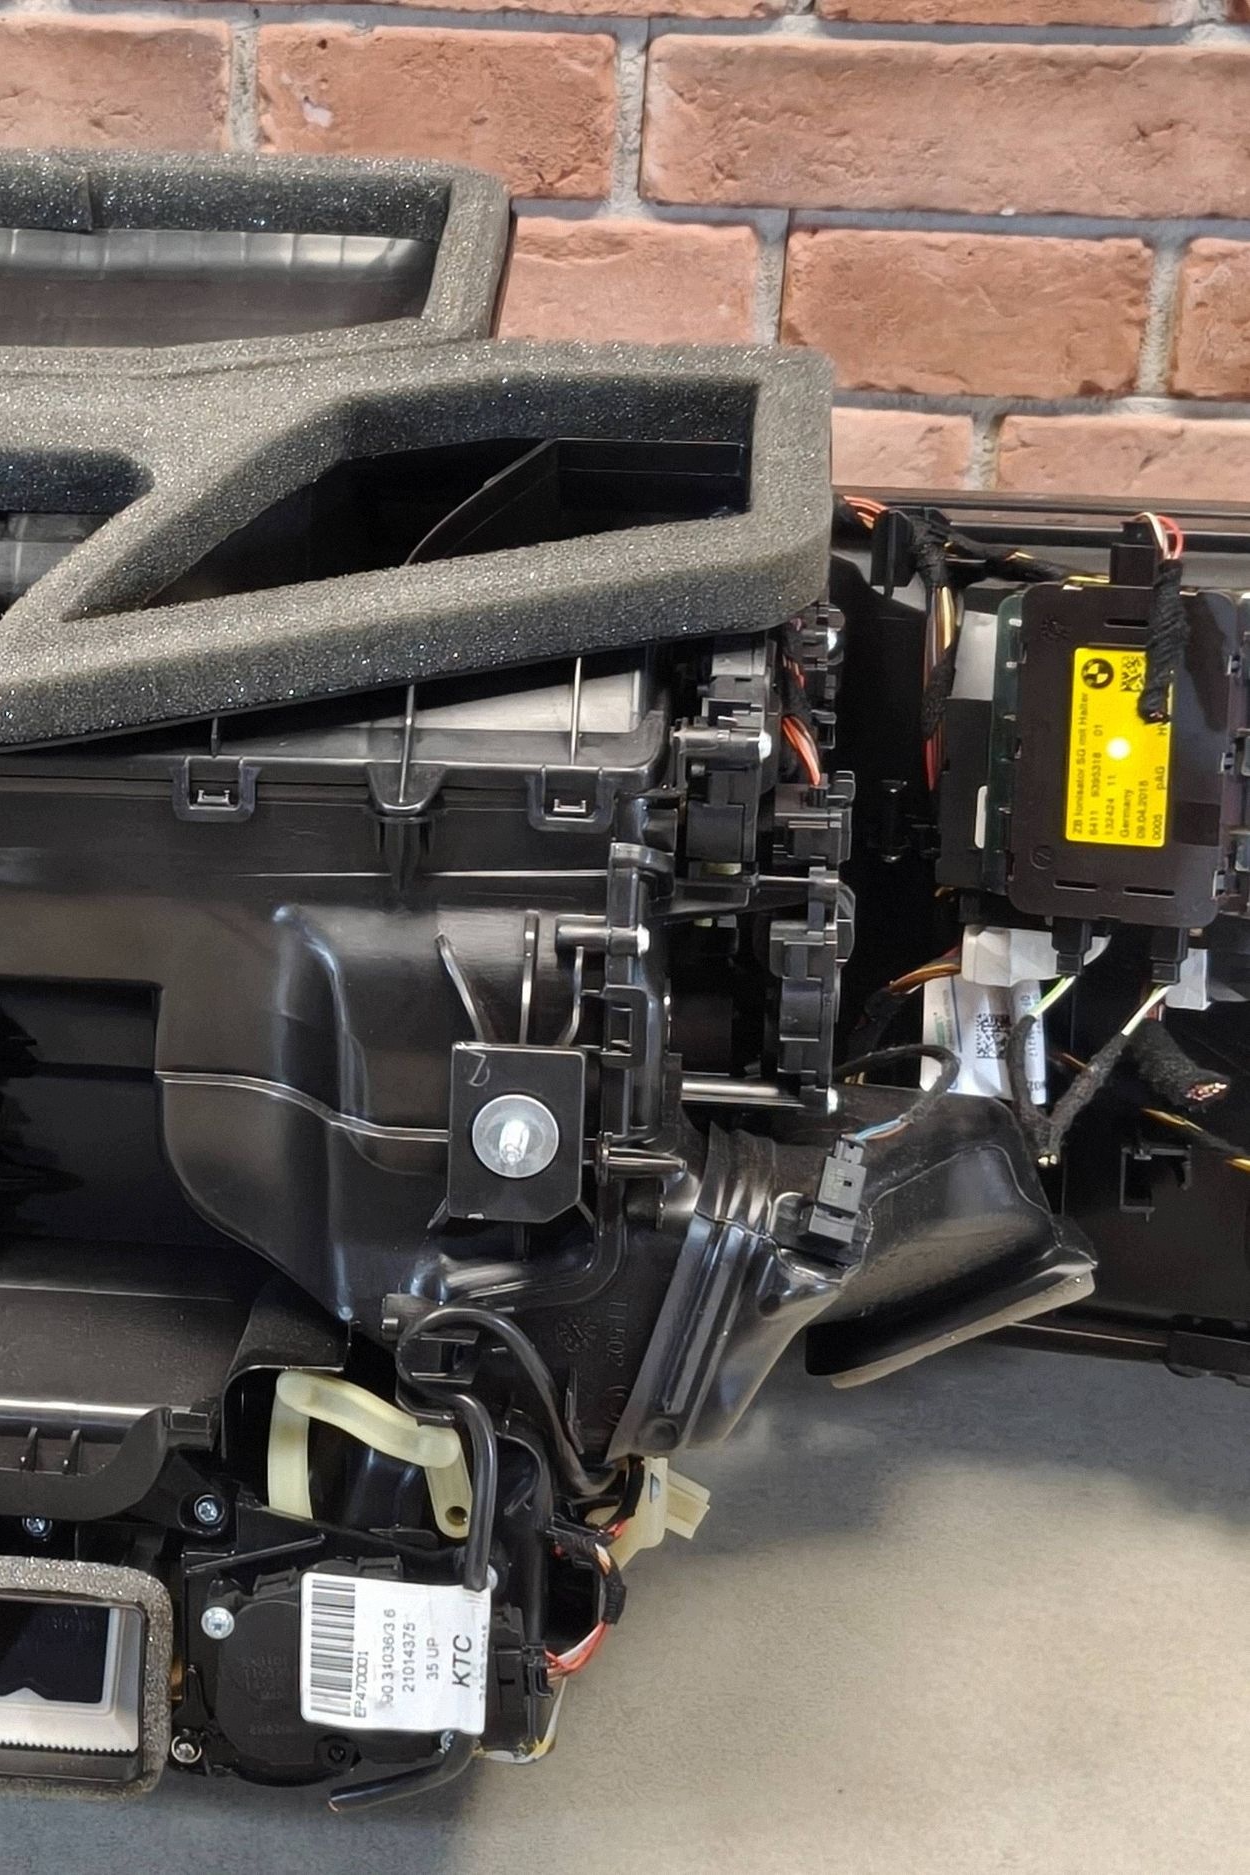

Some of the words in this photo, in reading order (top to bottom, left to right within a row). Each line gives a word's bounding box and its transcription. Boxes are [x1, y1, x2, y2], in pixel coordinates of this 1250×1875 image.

[1078, 693, 1089, 725] Halter
[1119, 788, 1134, 838] Germany
[402, 1622, 416, 1693] 21014375
[426, 1637, 440, 1659] UP
[452, 1634, 472, 1688] KTC
[426, 1663, 439, 1680] 35
